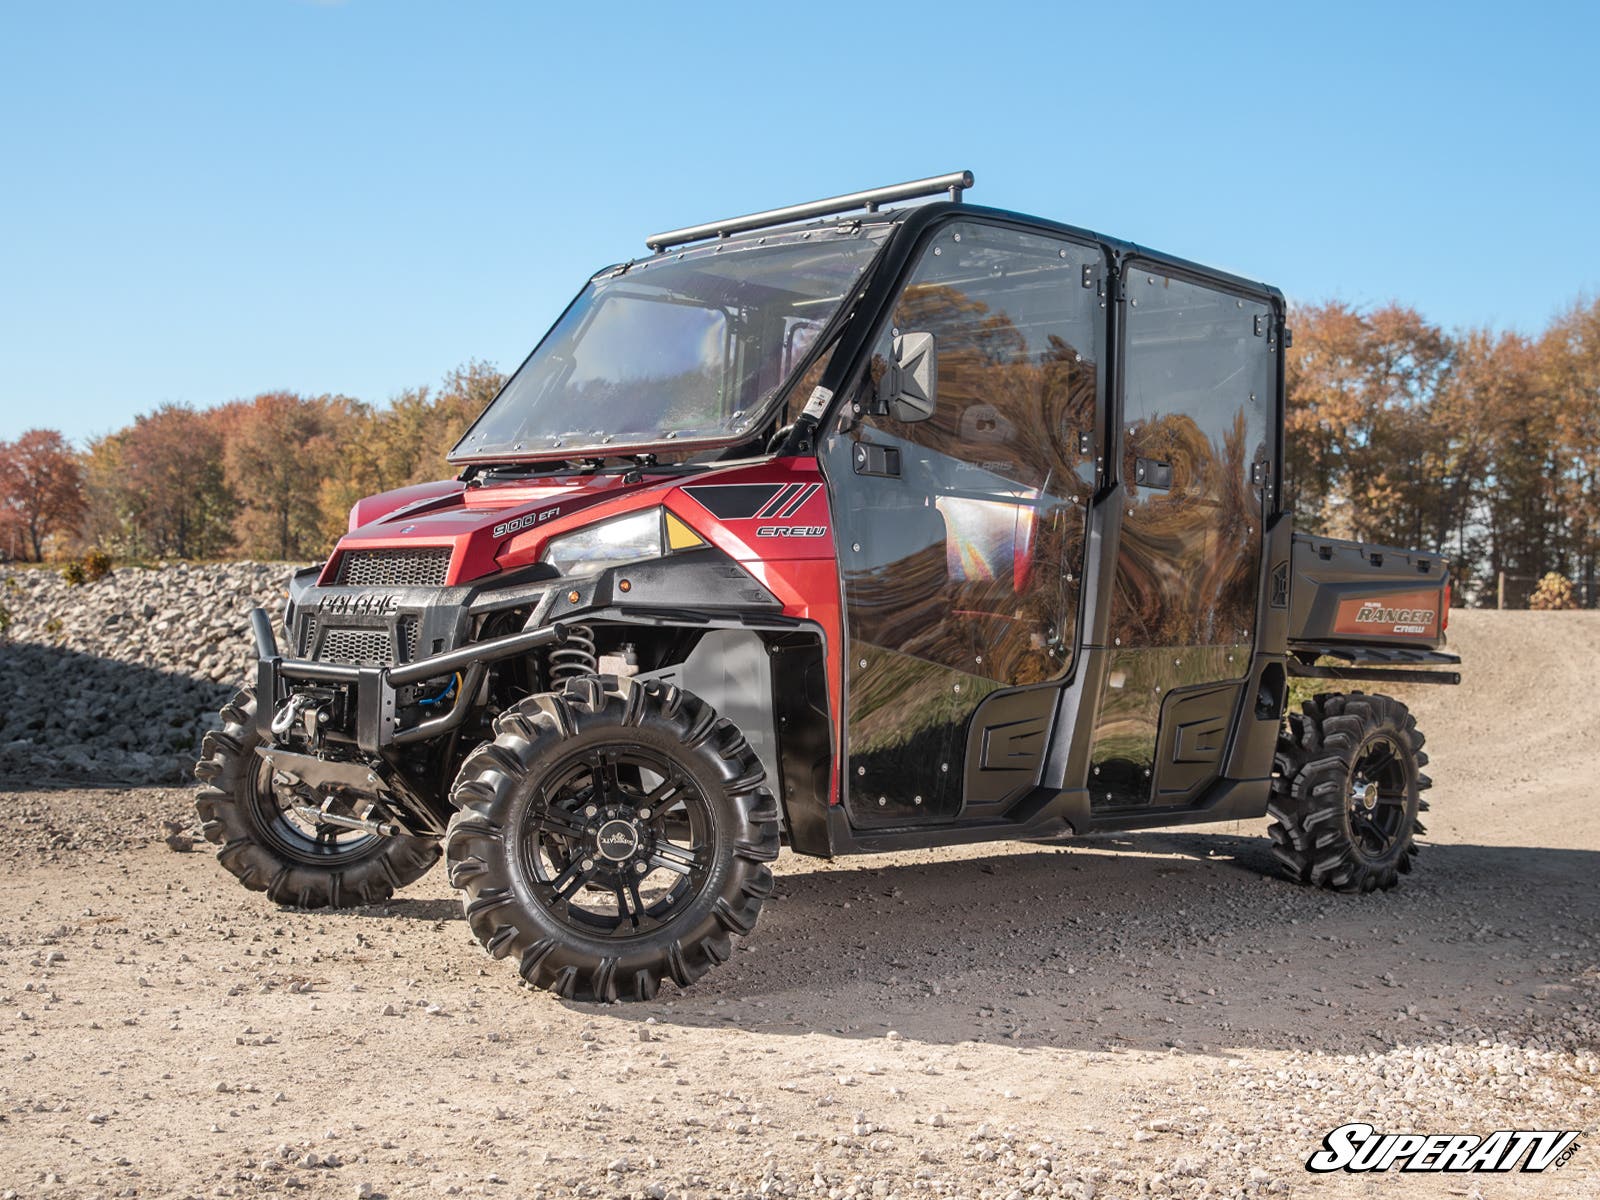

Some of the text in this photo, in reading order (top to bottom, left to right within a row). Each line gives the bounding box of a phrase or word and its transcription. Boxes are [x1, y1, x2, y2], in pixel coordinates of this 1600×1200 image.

[493, 507, 560, 538] 900 EFI
[756, 526, 827, 537] CREW
[1355, 607, 1434, 625] RANGER
[1393, 625, 1425, 633] CREW
